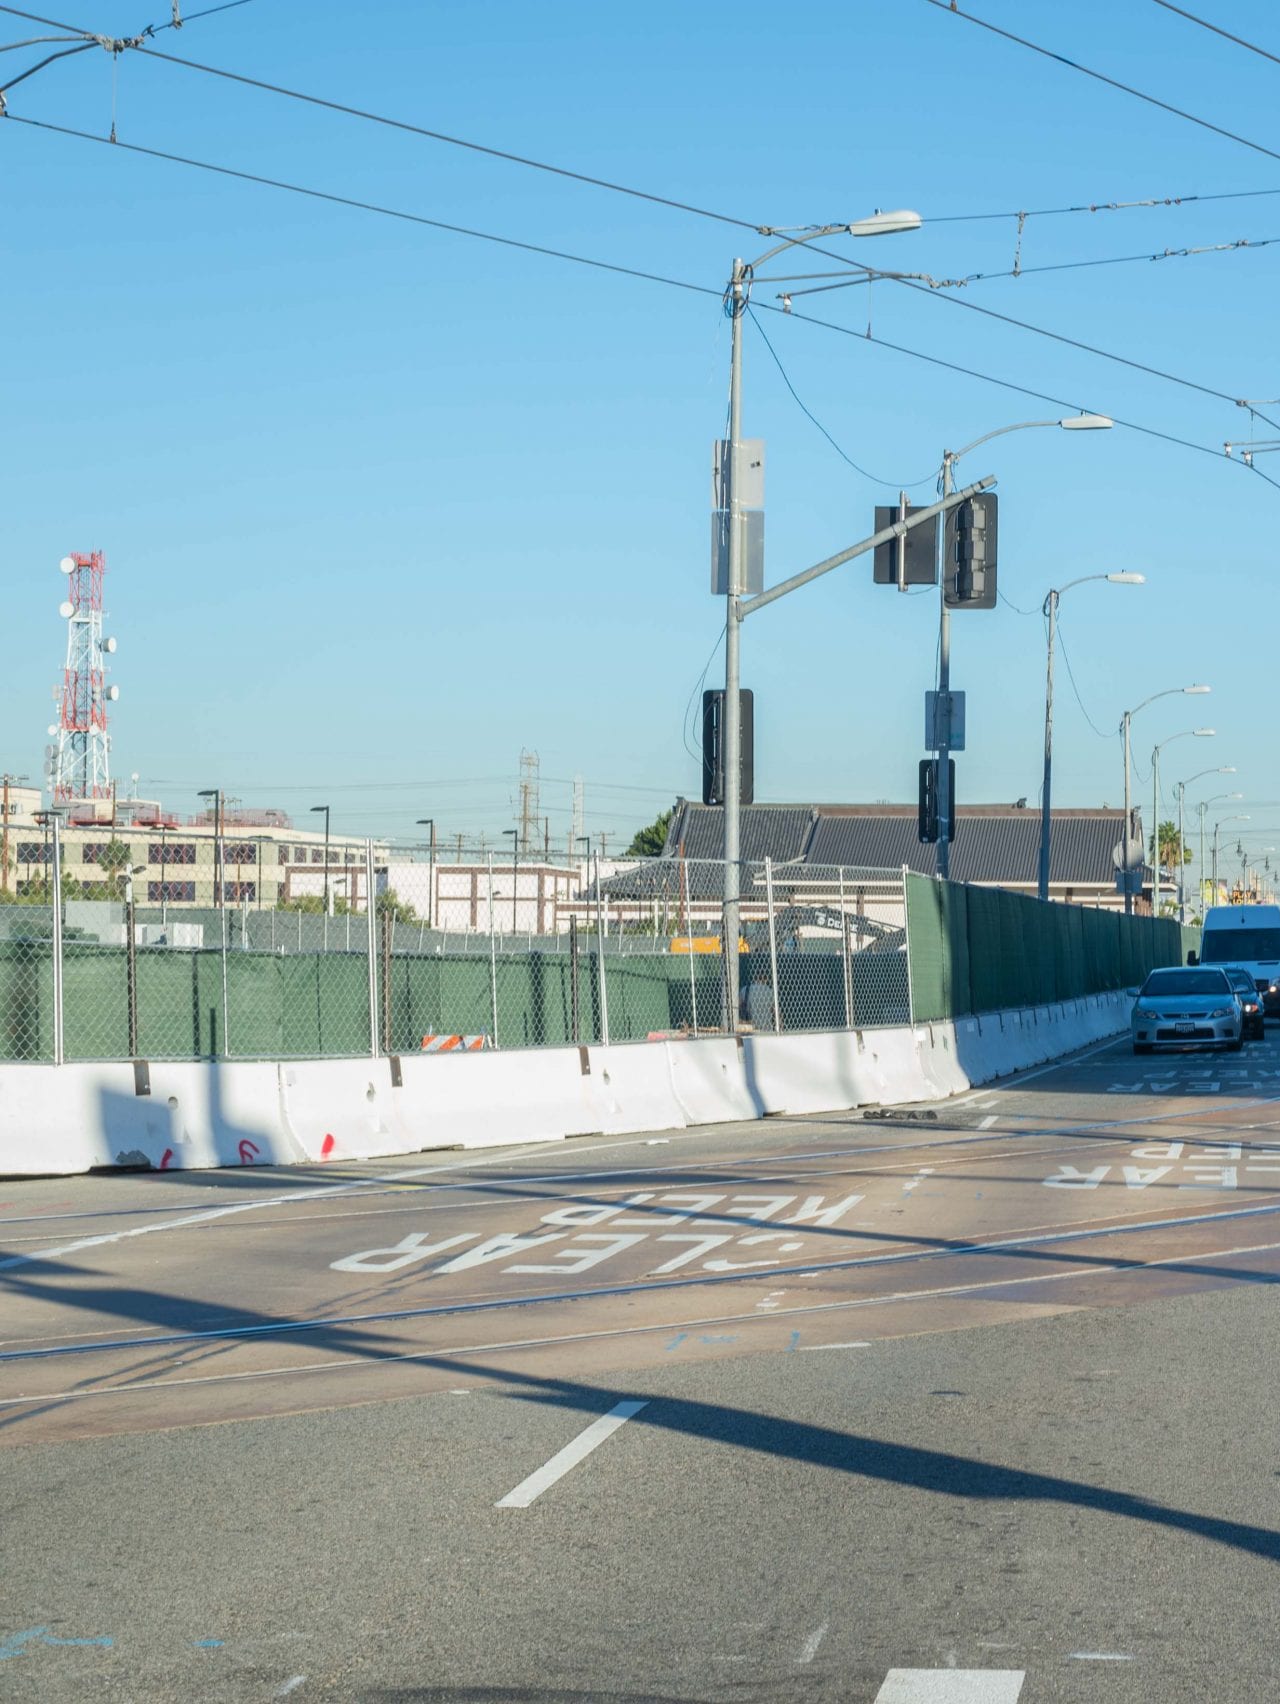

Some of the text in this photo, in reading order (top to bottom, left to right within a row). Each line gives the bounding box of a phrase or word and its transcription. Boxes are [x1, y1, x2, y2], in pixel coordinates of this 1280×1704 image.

[827, 917, 858, 932] DEE
[539, 1193, 866, 1226] KEEP
[329, 1232, 805, 1275] CLEAR
